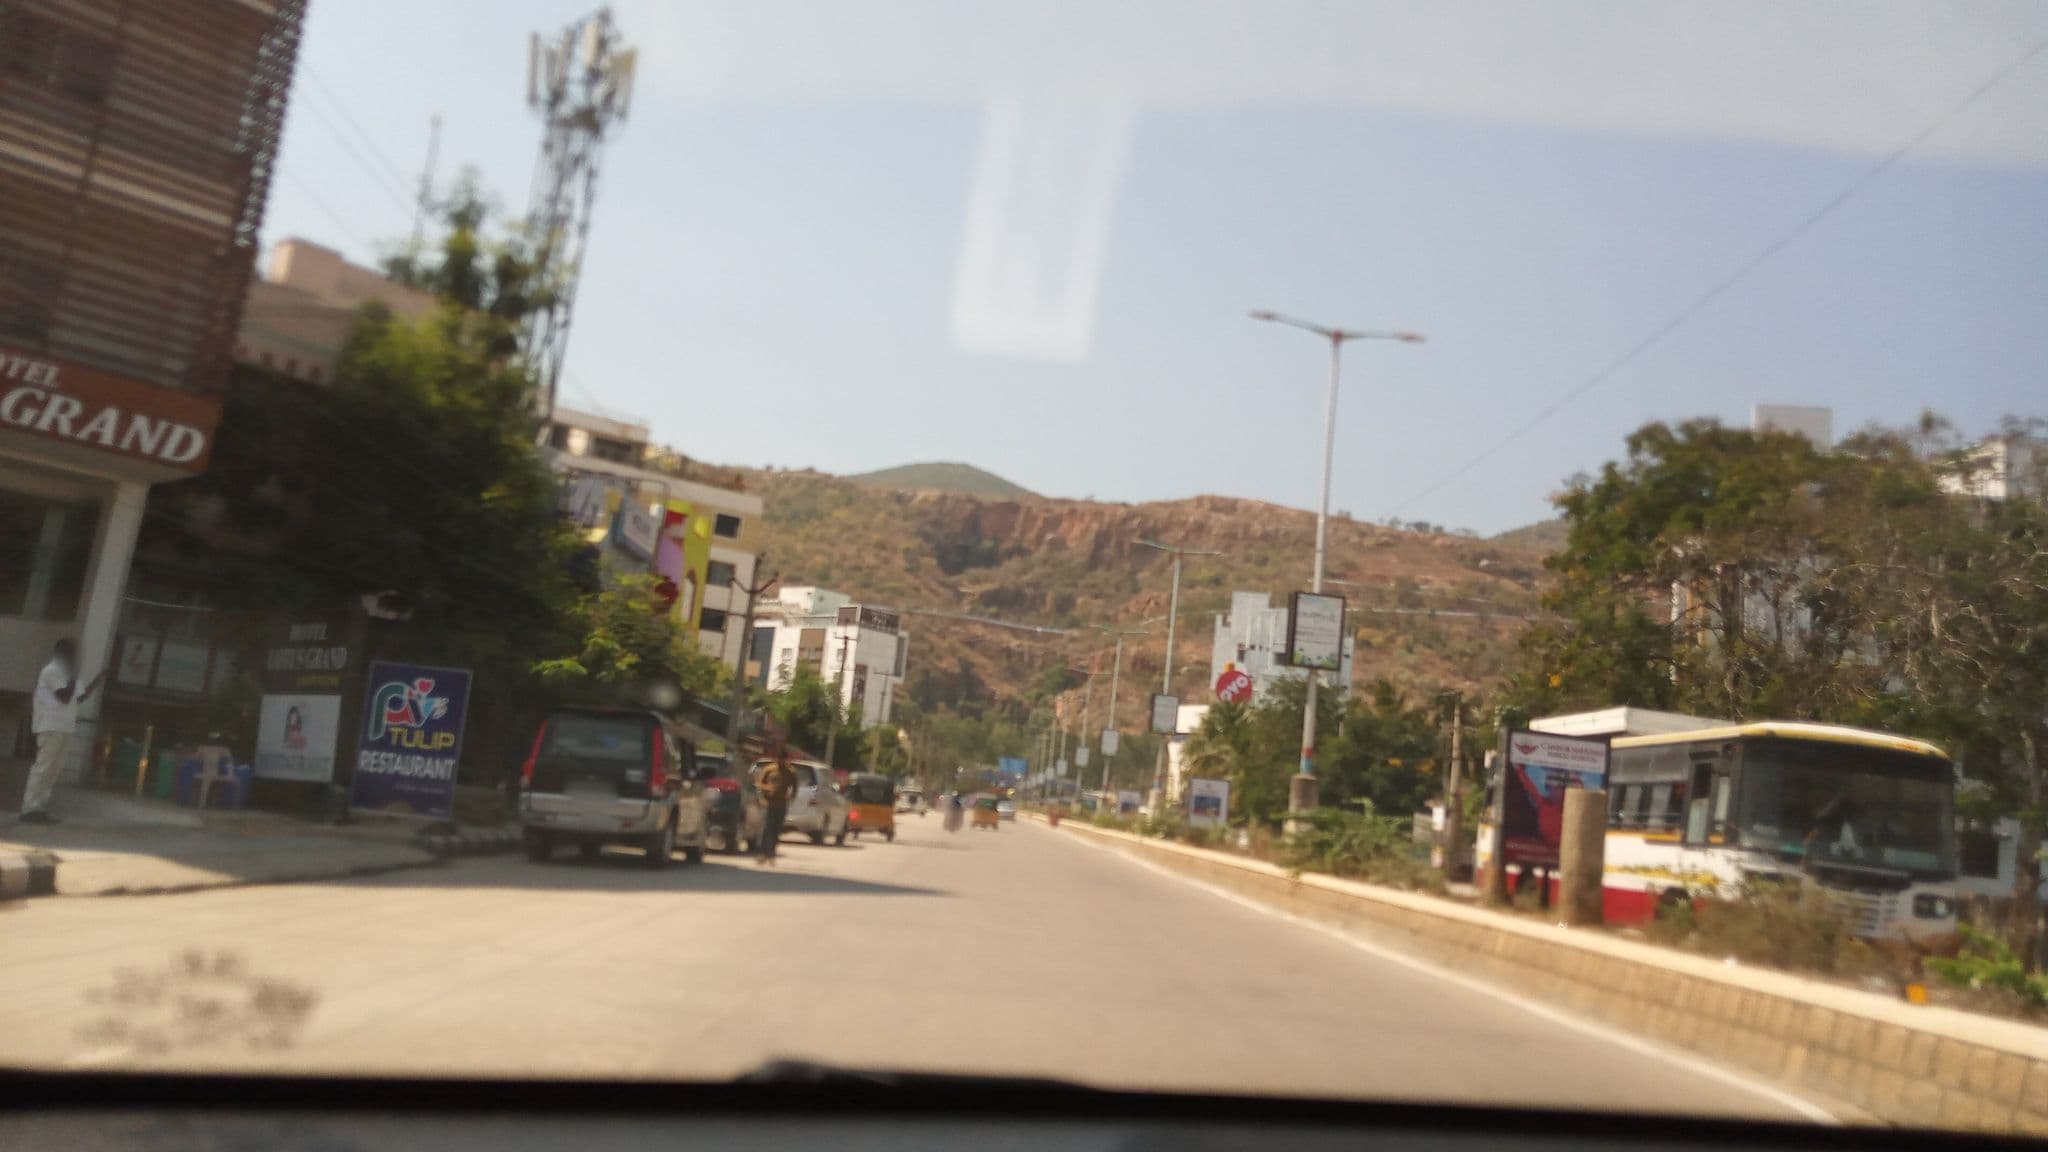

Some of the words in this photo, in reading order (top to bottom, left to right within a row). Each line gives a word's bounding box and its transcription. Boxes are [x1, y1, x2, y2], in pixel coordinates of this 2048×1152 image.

[0, 387, 206, 462] GRAND
[389, 726, 455, 750] TULIP
[358, 750, 456, 781] RESTAURANT
